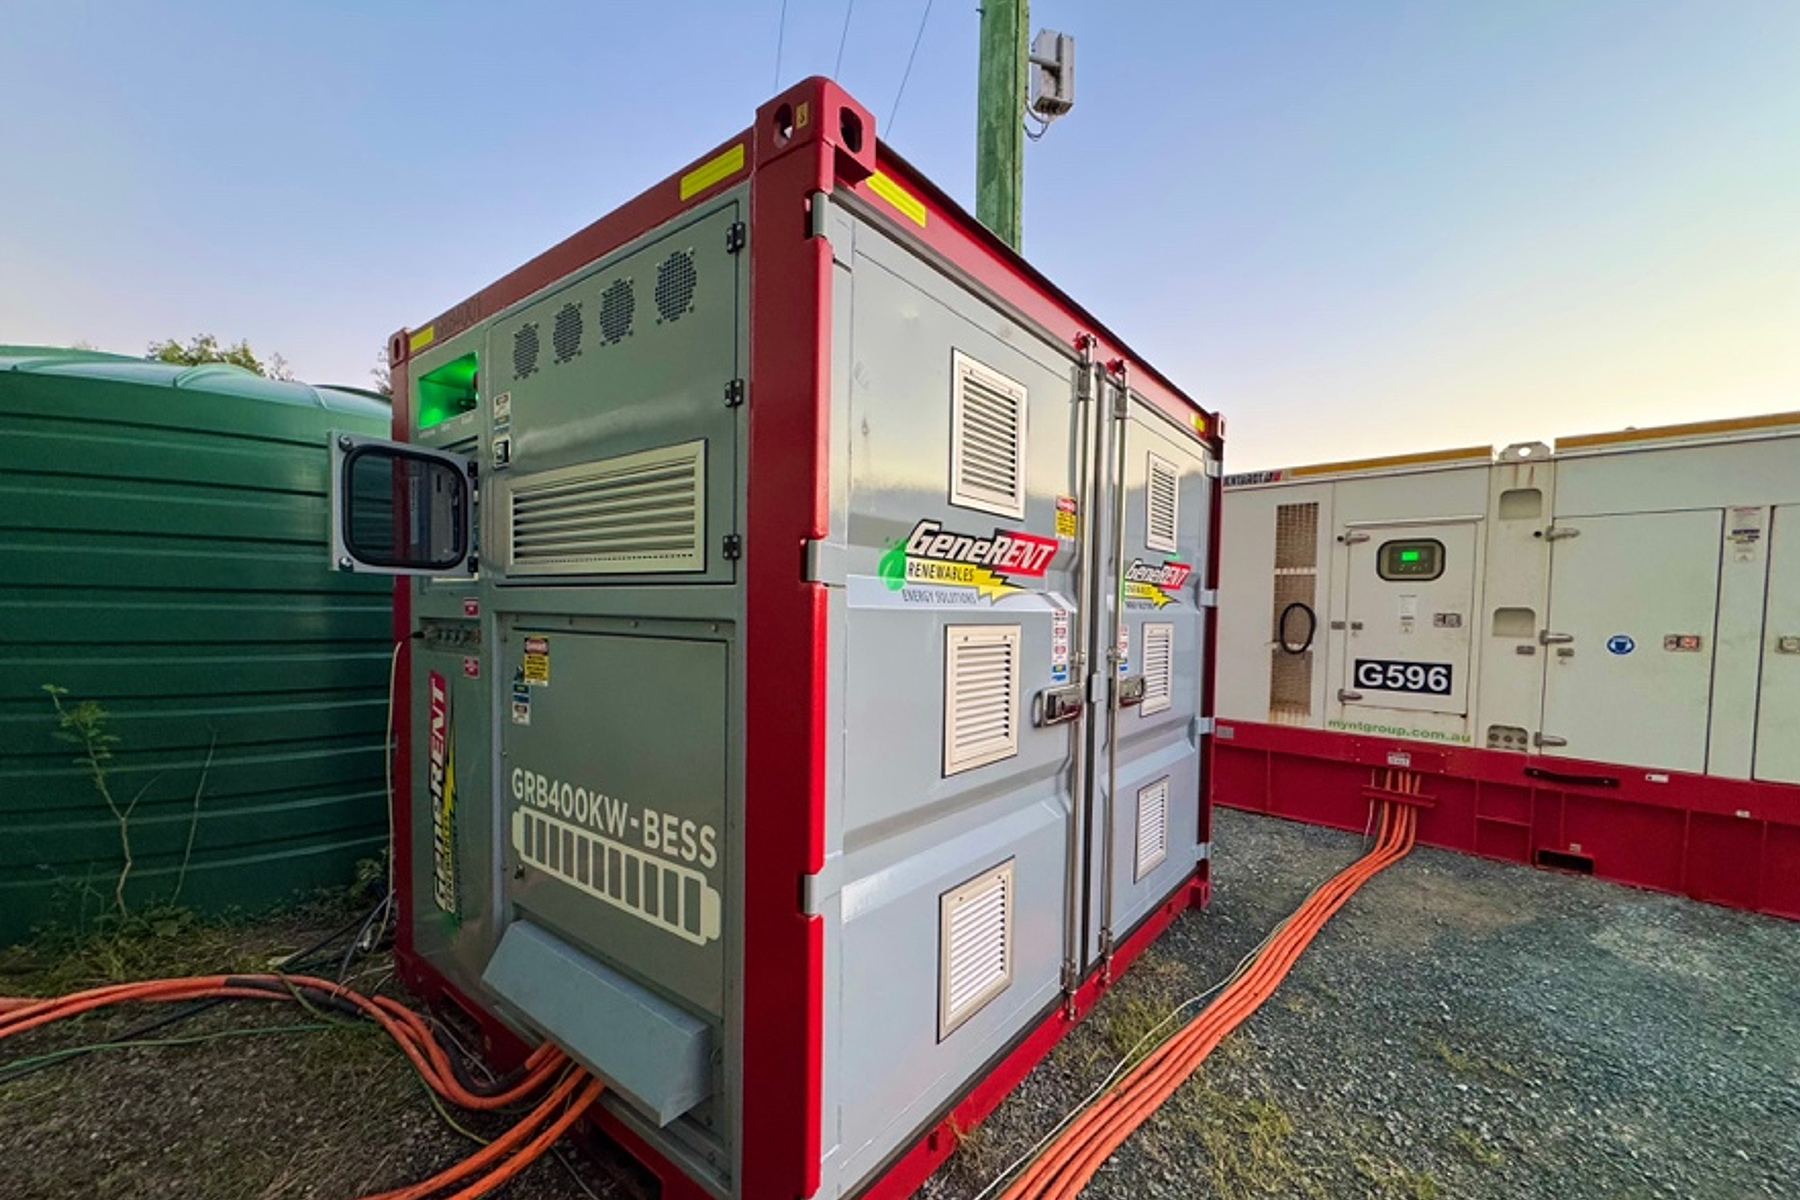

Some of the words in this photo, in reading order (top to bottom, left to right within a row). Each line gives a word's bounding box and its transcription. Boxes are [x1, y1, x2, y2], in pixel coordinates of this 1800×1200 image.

[906, 519, 1057, 571] GeneRENT
[908, 561, 975, 582] RENEWABLES
[902, 588, 934, 603] ENERGY
[935, 589, 977, 605] SOLUTIONS
[1357, 662, 1449, 692] G596
[1328, 719, 1471, 743] myntgroup.com.au
[511, 767, 718, 870] GRB400KW-BESS
